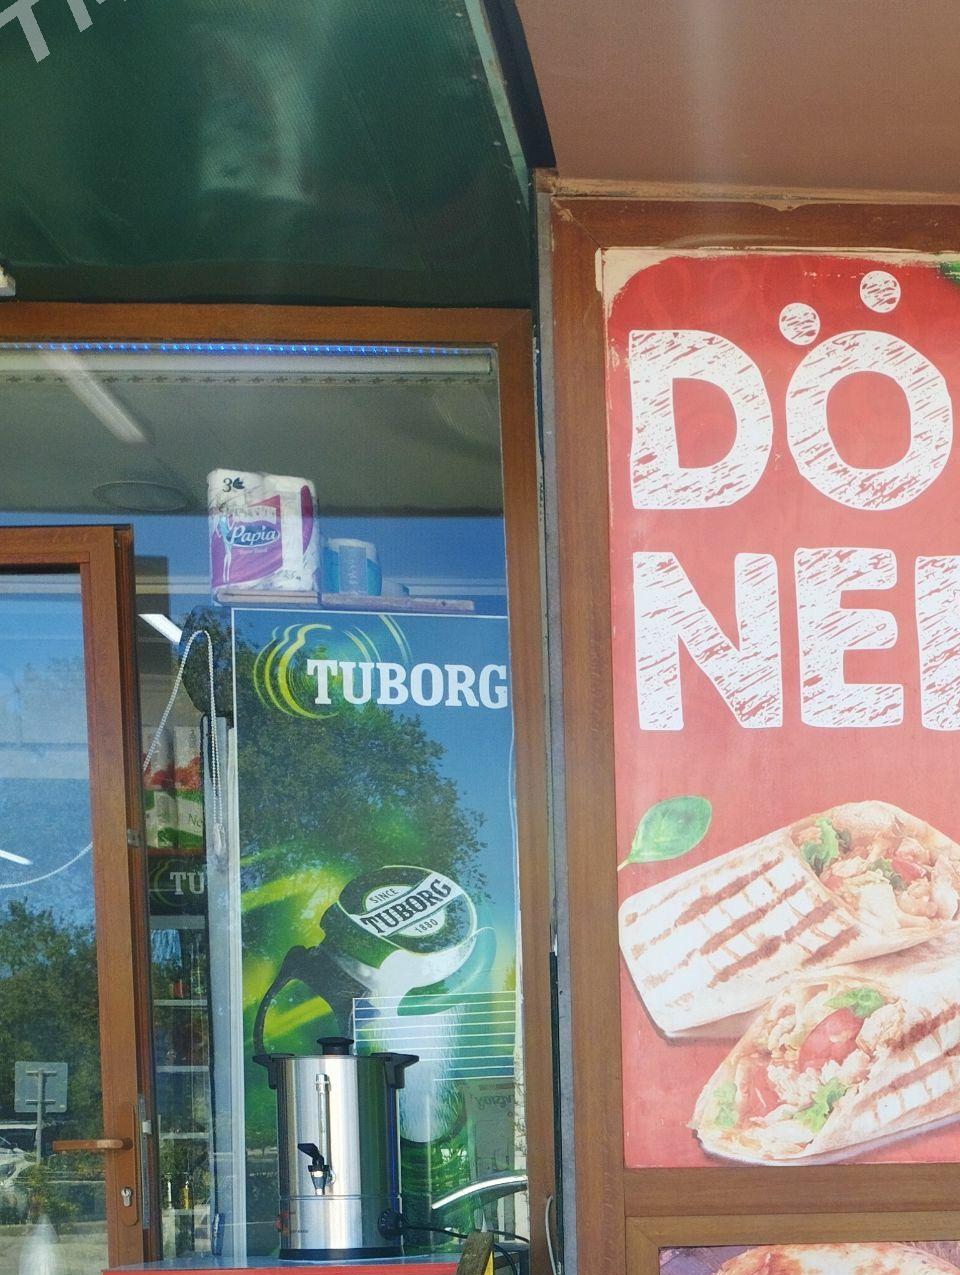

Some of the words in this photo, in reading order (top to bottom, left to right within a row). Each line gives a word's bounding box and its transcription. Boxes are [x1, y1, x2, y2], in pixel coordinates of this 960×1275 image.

[629, 270, 954, 511] DÖ
[230, 525, 276, 545] Papia
[306, 658, 508, 709] TUBORG
[360, 878, 452, 934] TUBORG
[369, 888, 399, 904] SINCE
[414, 918, 438, 934] 1880
